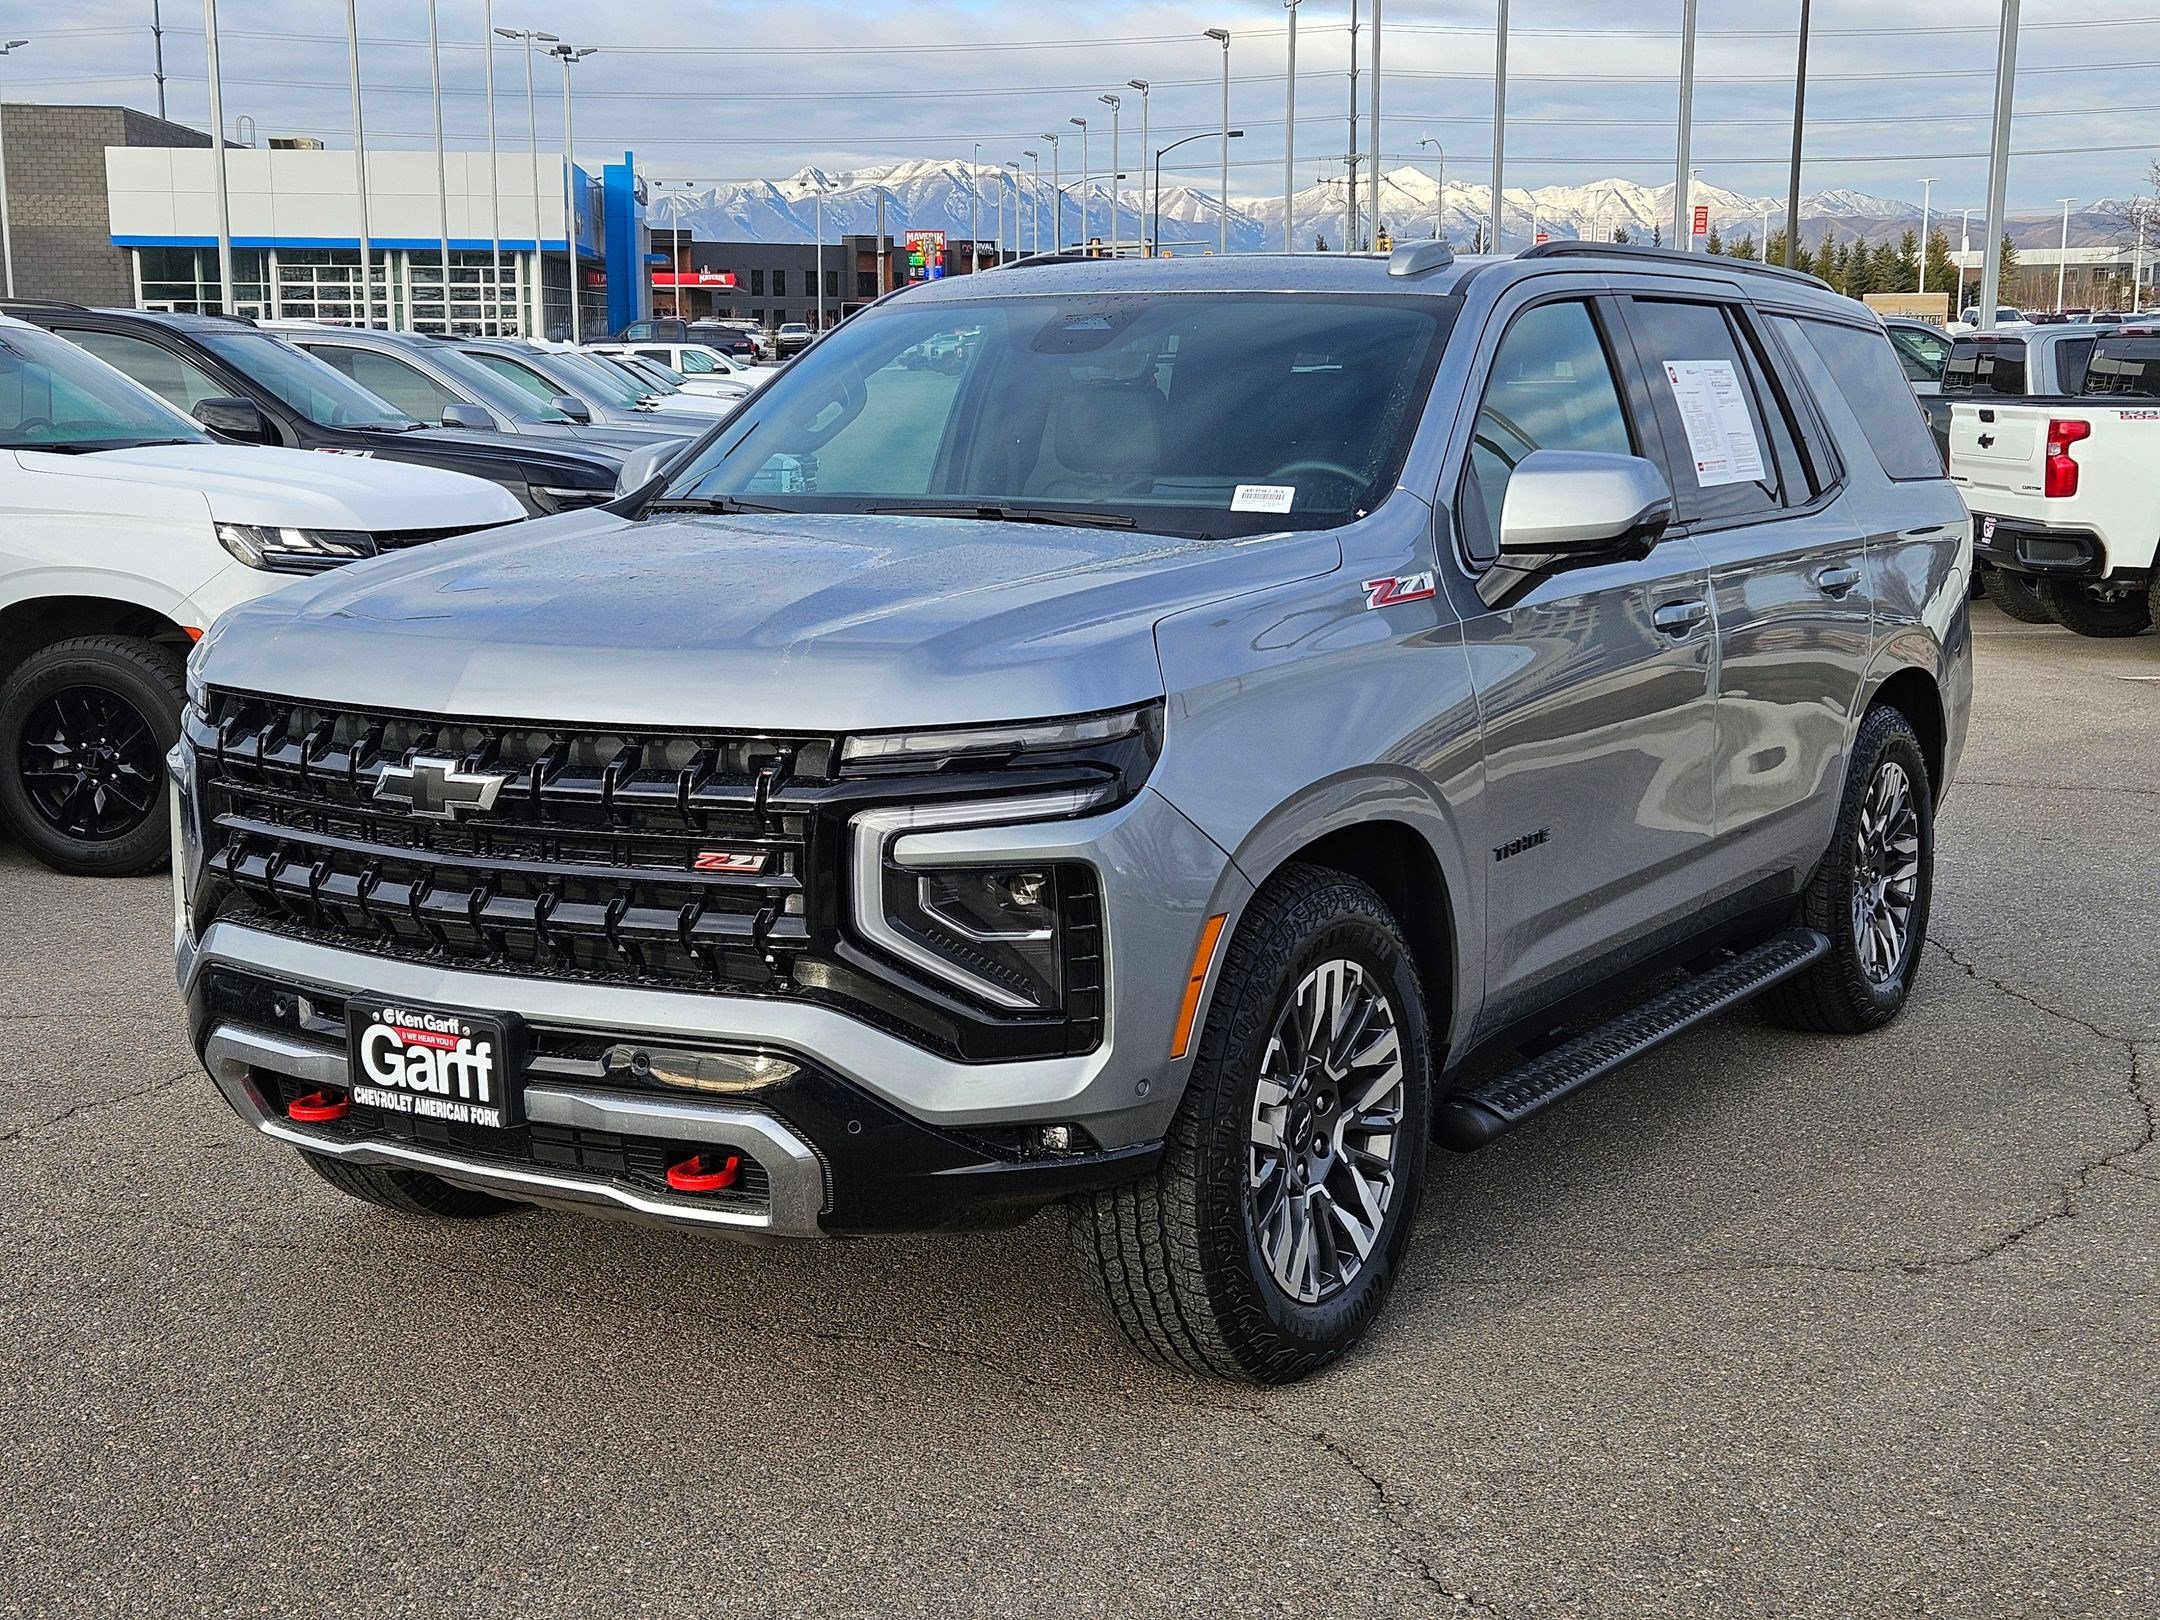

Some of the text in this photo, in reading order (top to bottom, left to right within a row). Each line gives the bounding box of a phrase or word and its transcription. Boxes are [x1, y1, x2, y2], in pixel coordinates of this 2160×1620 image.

[1361, 570, 1436, 611] Z71
[693, 851, 767, 873] Z71
[1492, 825, 1552, 863] TAHOE
[395, 1009, 424, 1029] Ken
[424, 1014, 459, 1034] Garff
[407, 1033, 449, 1046] WE HEAR YOU
[361, 1024, 493, 1103] Garff
[353, 1086, 501, 1129] CHEVROLET AMERICAN FORK
